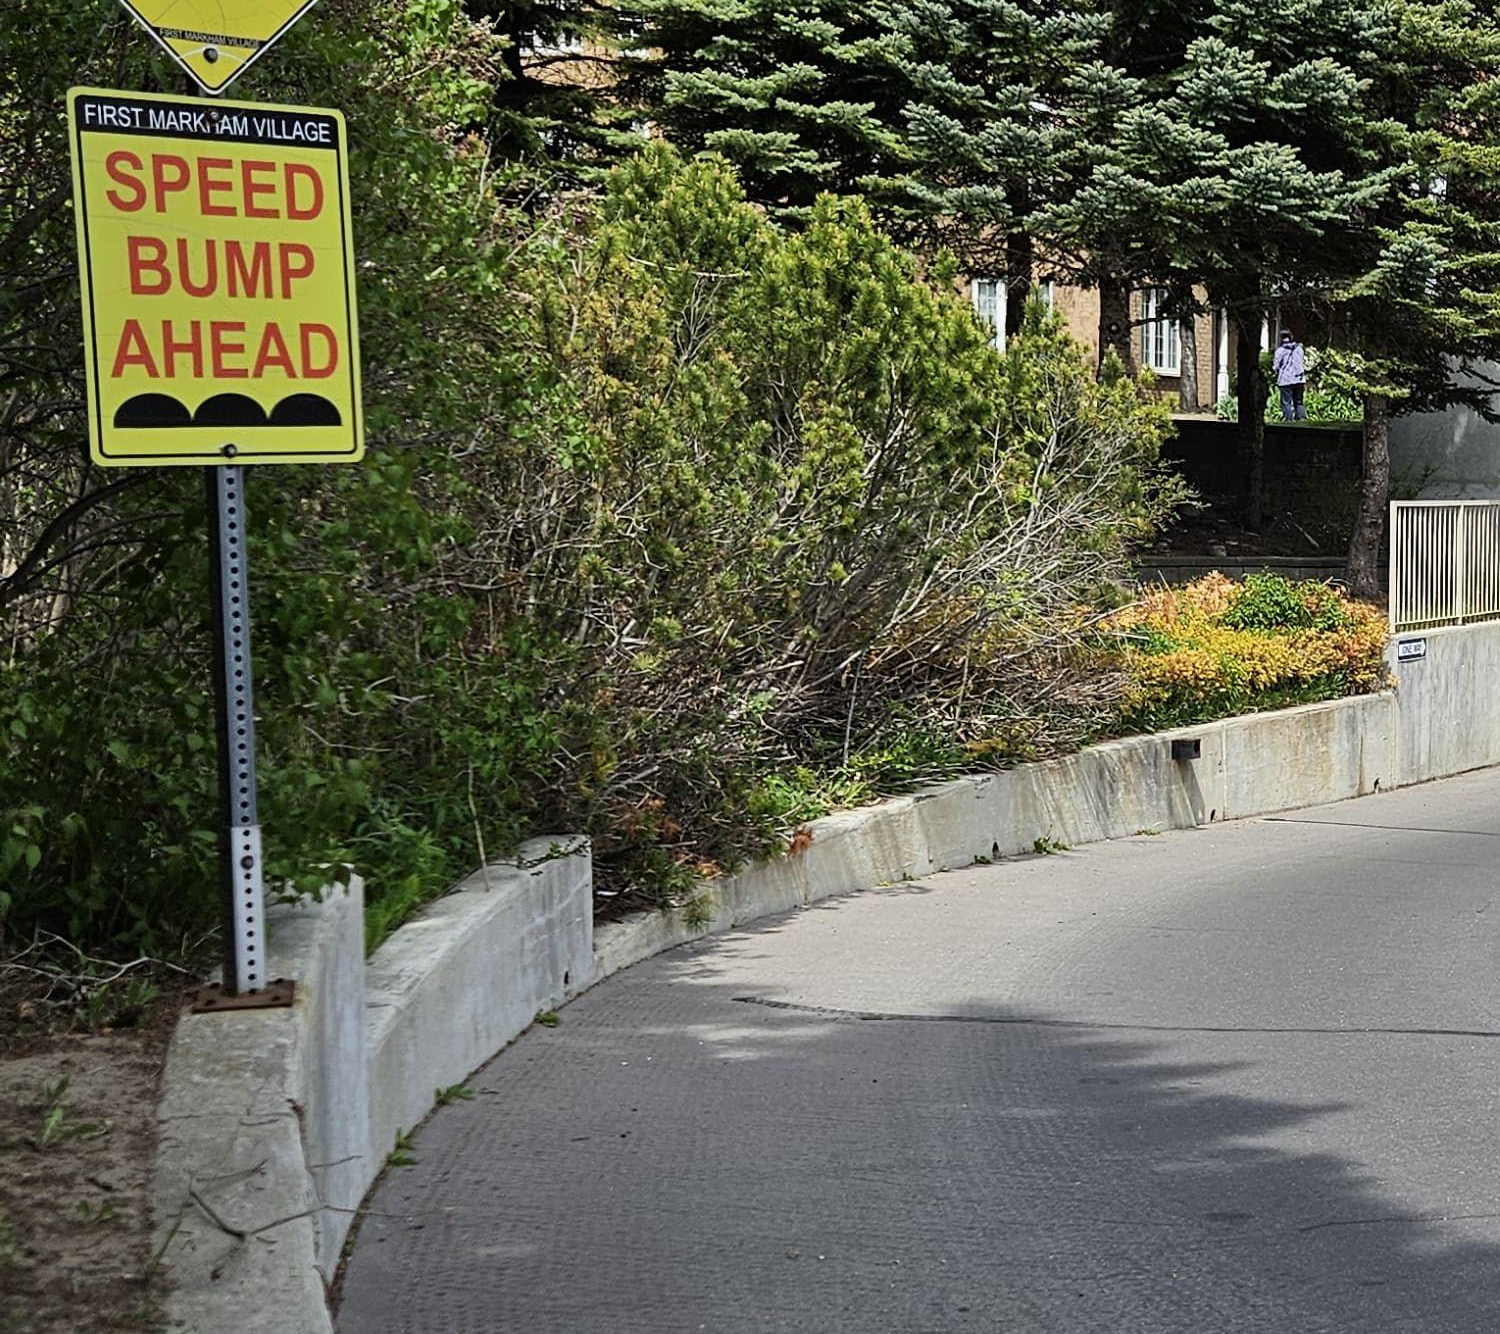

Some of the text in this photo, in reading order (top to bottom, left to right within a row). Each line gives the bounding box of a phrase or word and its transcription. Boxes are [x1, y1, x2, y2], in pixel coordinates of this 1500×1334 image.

[160, 29, 260, 47] FIRST MARKHAM VILLAGE
[84, 103, 144, 128] FIRST
[253, 117, 332, 143] VILLAGE
[105, 150, 324, 221] SPEED
[127, 235, 315, 300] BUMP
[111, 318, 339, 380] AHEAD
